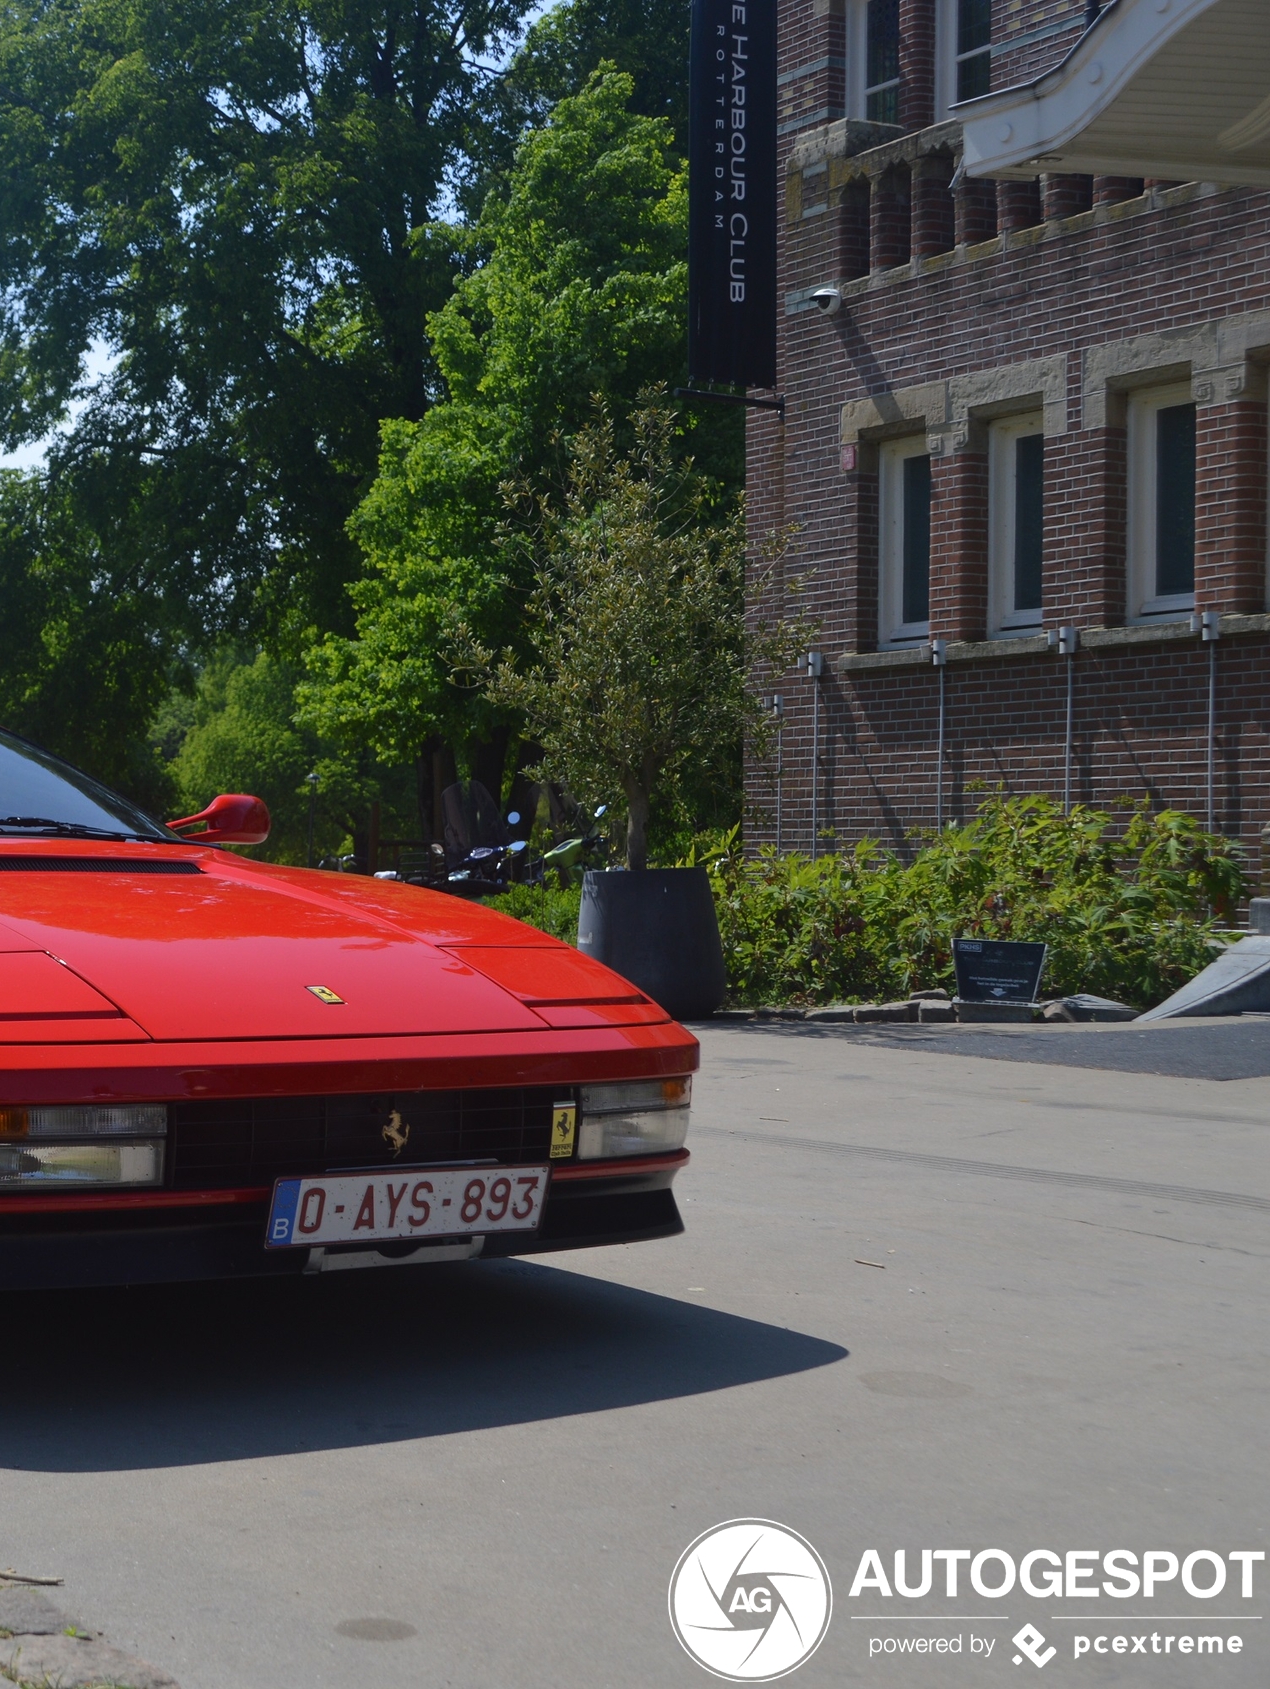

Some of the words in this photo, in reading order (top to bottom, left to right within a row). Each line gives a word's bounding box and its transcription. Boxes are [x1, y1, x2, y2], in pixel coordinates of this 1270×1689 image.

[714, 25, 725, 229] ROTTERDAM
[730, 34, 748, 201] HARBOUR
[730, 212, 748, 303] CLUB
[272, 1217, 289, 1239] B
